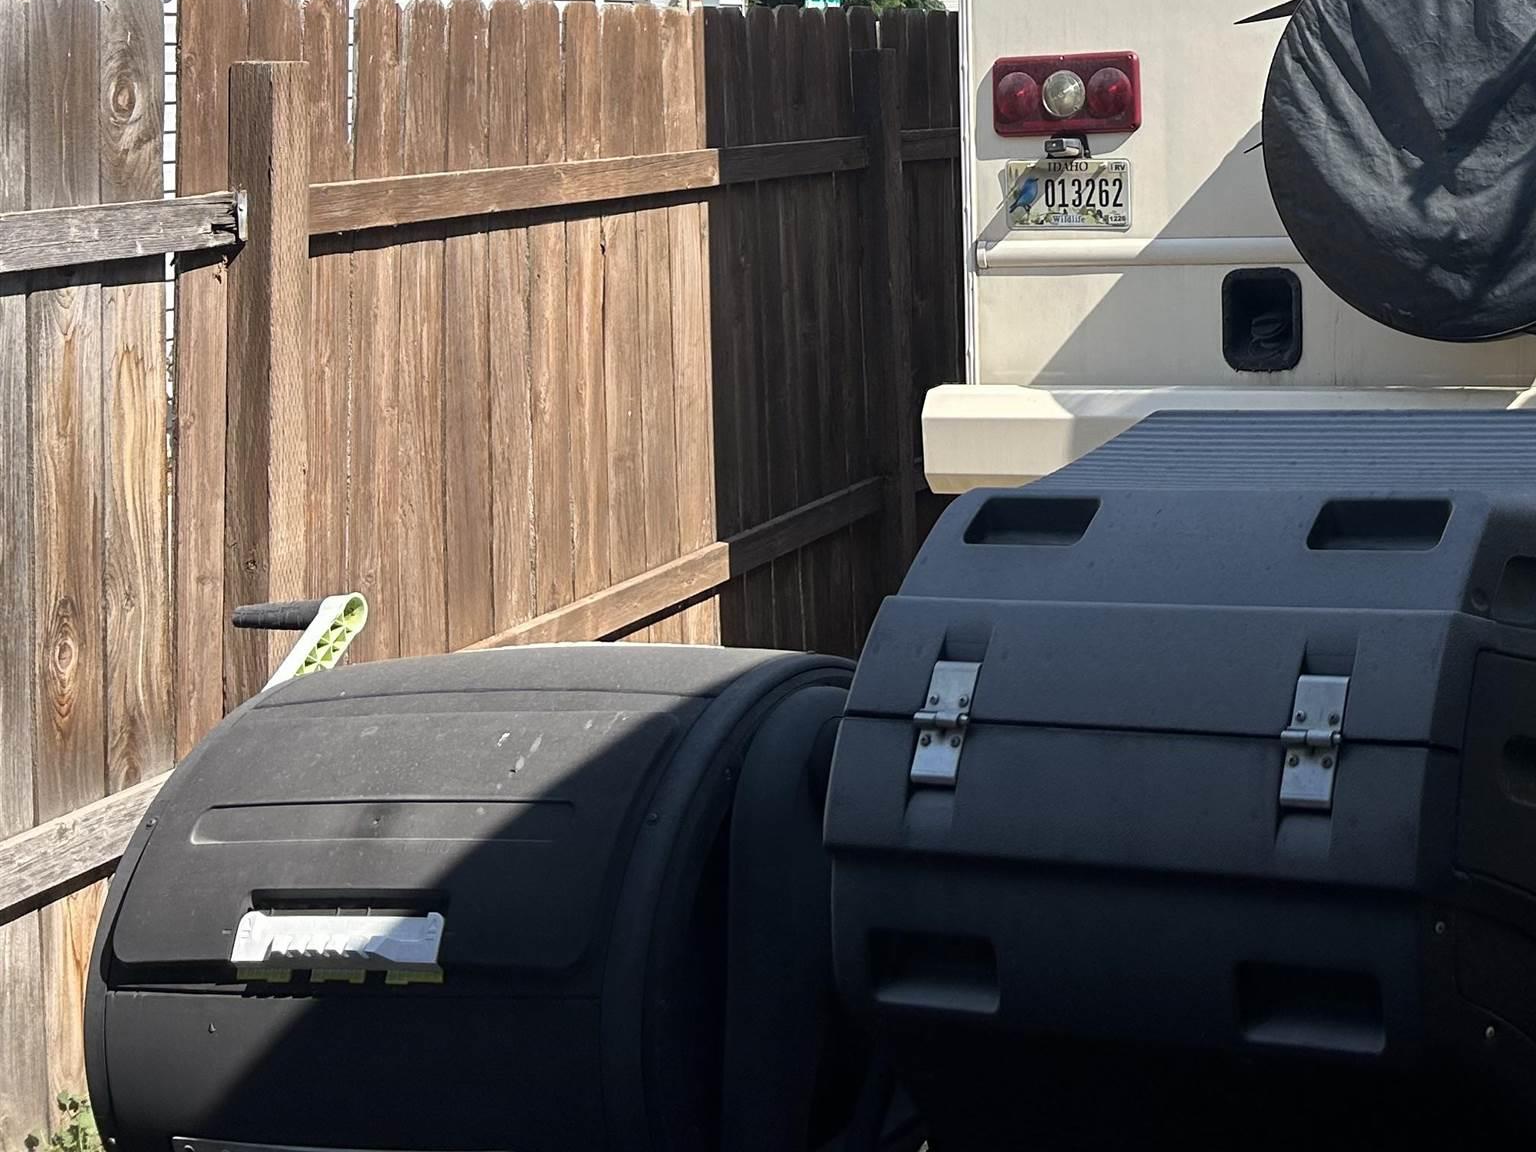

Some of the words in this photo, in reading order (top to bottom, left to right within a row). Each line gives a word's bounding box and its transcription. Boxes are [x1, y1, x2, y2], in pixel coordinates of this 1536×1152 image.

[1048, 161, 1089, 172] IDAHO
[1044, 178, 1123, 208] 013262
[1053, 215, 1085, 223] Wildlife
